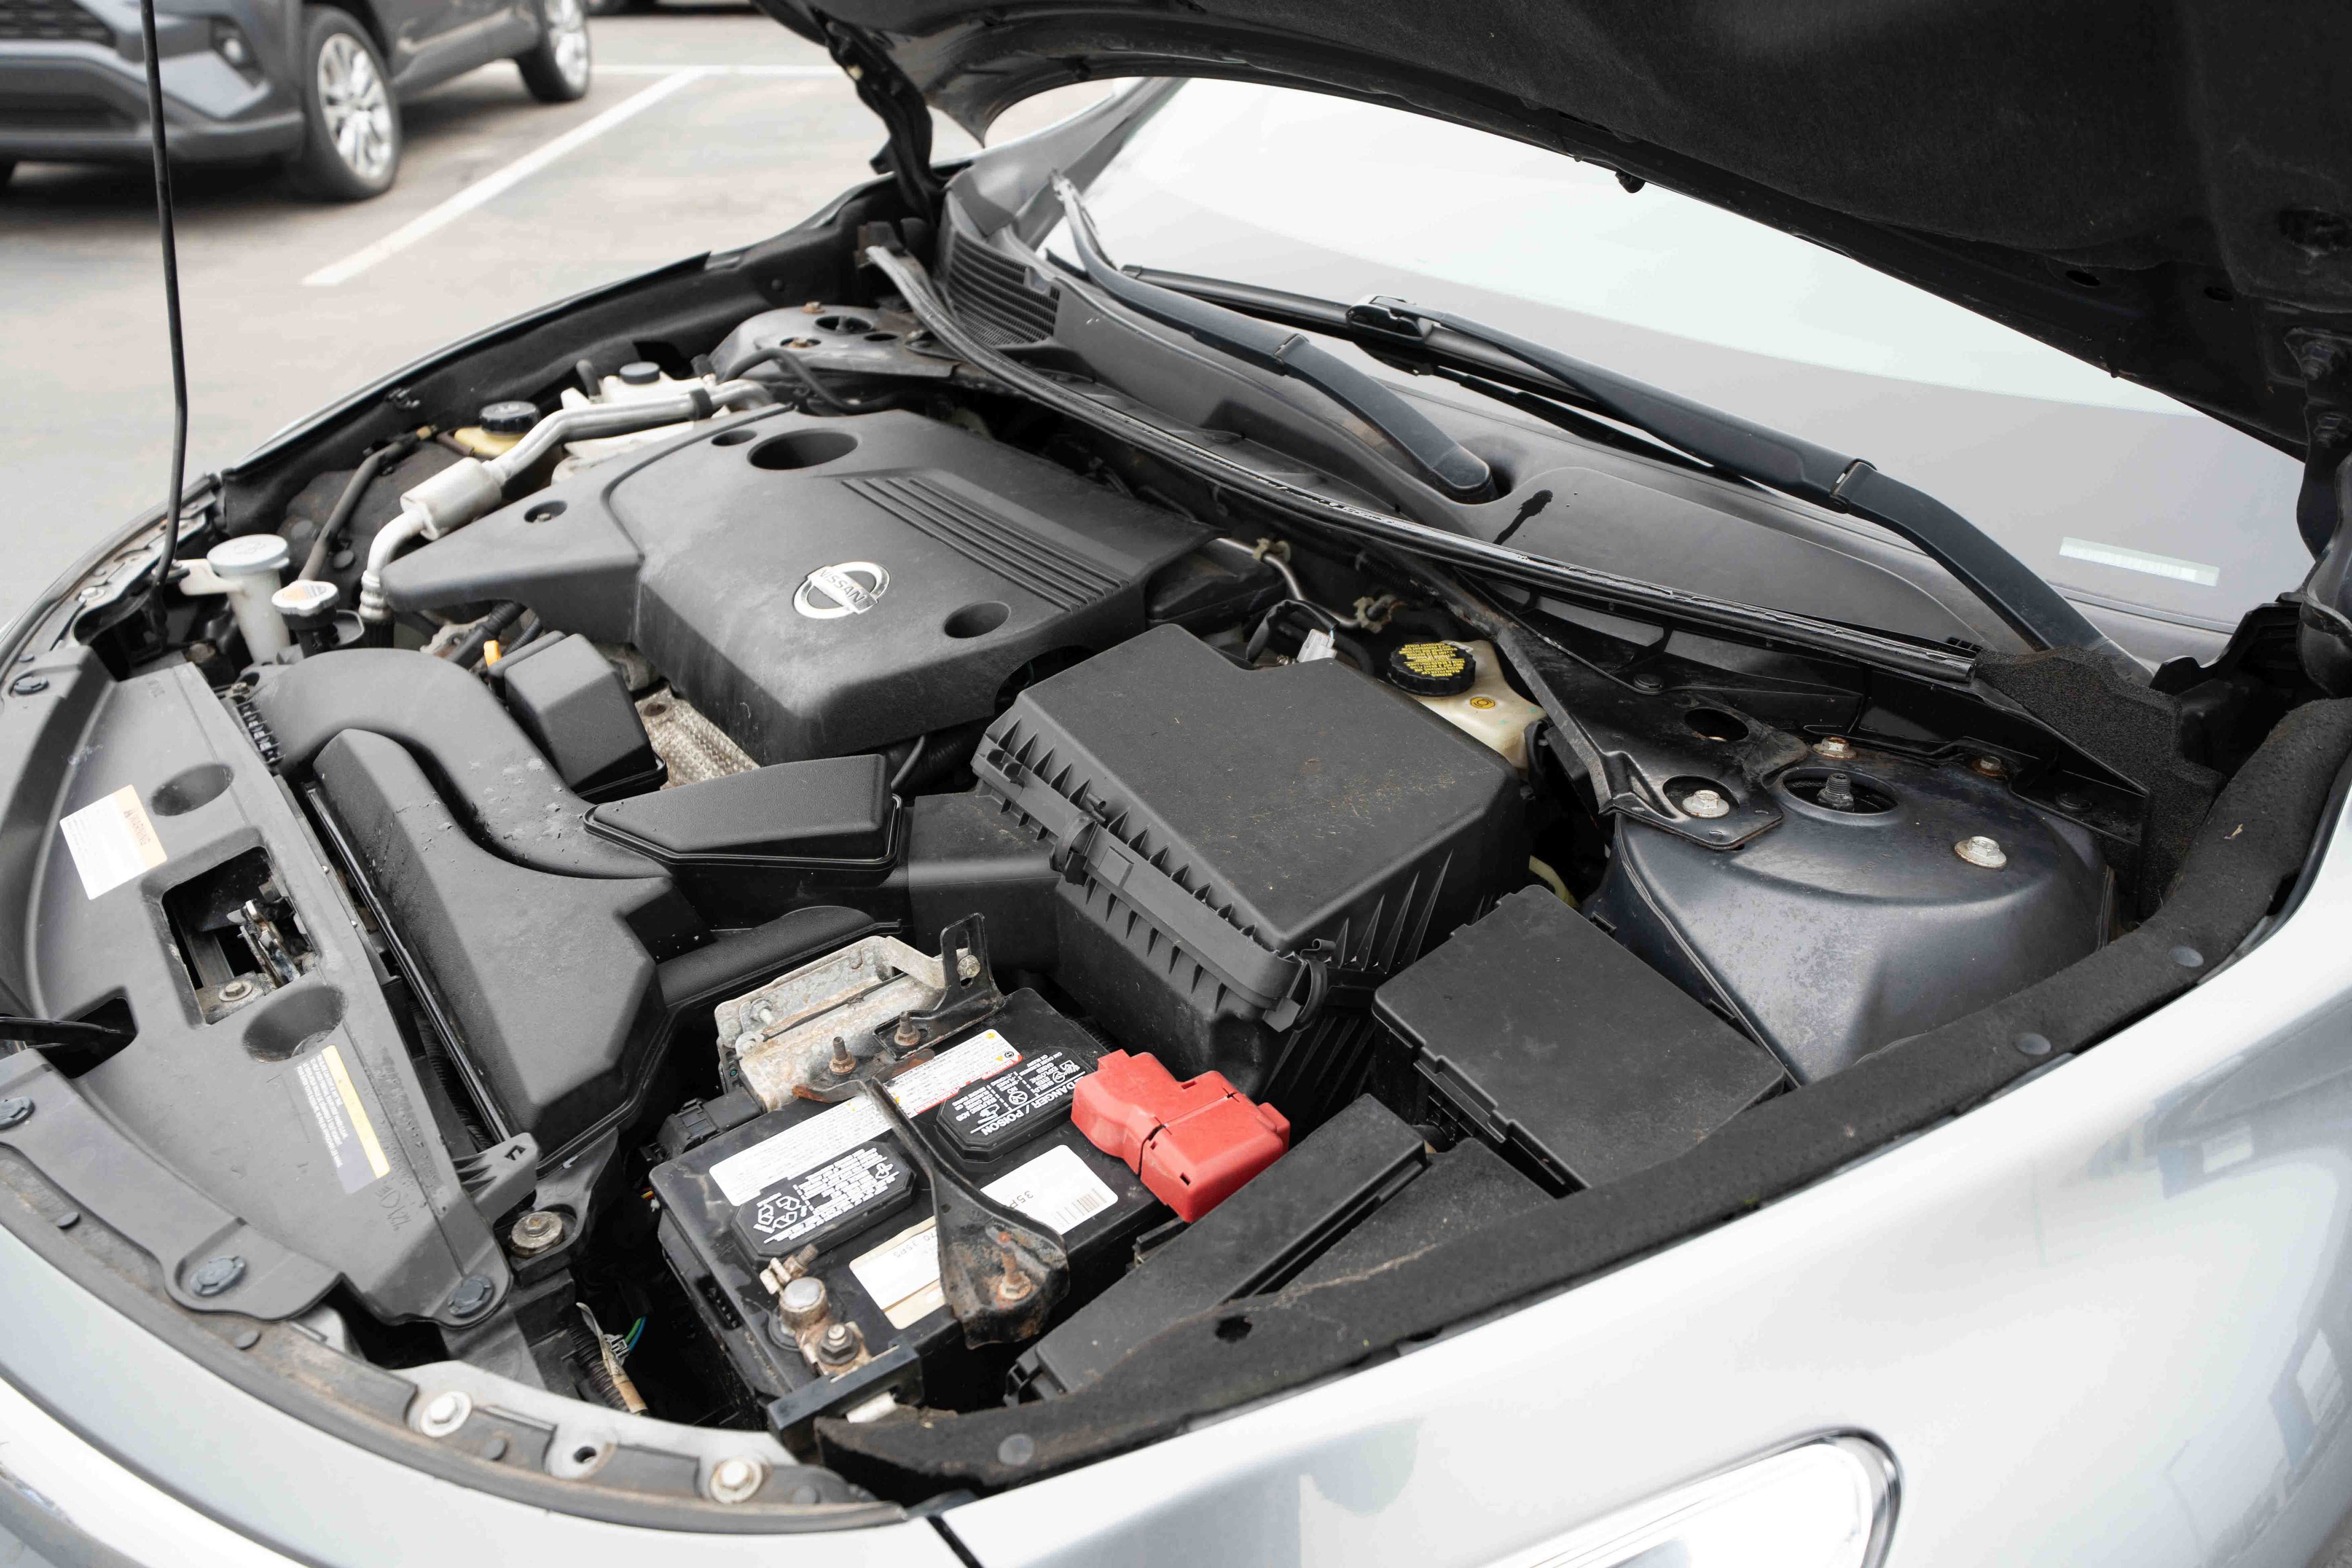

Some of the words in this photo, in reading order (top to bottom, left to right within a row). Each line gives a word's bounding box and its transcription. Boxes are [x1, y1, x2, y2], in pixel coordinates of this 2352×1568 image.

[820, 569, 867, 604] NISSAN
[1029, 1065, 1058, 1083] EXPLOSIVE
[1036, 1062, 1054, 1074] GASES
[1033, 1079, 1054, 1093] SHIELD
[1034, 1076, 1050, 1086] EYES
[981, 1093, 993, 1101] CAN
[1007, 1086, 1018, 1094] NO
[1030, 1081, 1076, 1109] DANGER
[969, 1096, 997, 1114] SULFURIC
[955, 1111, 971, 1122] ACID
[980, 1109, 1024, 1136] POISON
